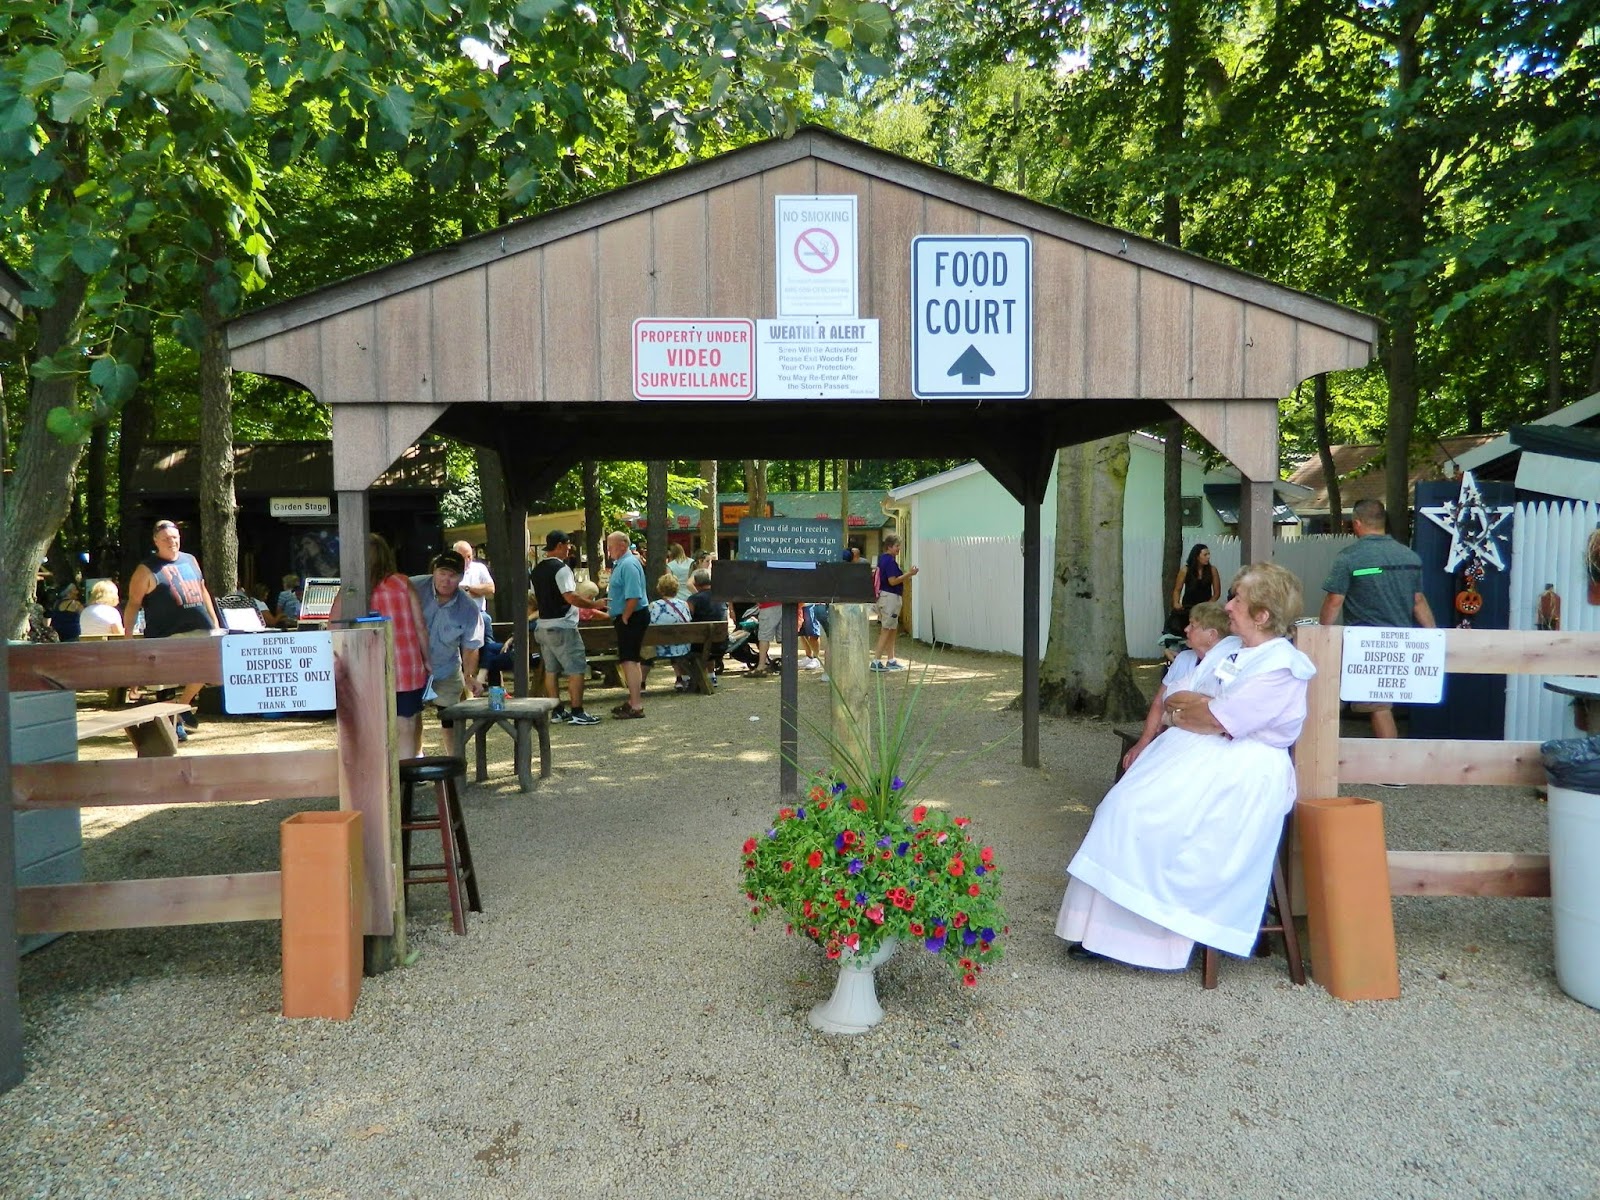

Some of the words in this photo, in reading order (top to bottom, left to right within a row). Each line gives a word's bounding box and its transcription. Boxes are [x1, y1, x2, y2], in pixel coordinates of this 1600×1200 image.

[783, 211, 798, 222] NO
[801, 211, 849, 222] SMOKING
[936, 251, 1008, 286] FOOD
[926, 299, 1016, 334] COURT
[641, 331, 702, 342] PROPERTY
[707, 331, 747, 342] UNDER
[830, 326, 865, 339] ALERT
[667, 349, 720, 366] VIDEO
[641, 373, 747, 387] SURVEILLANCE
[305, 503, 326, 511] Stage
[750, 546, 774, 554] Name,
[263, 637, 295, 645] BEFORE
[1361, 640, 1398, 648] ENTERING
[241, 647, 282, 656] ENTERING
[1365, 652, 1405, 662] DISPOSE
[1412, 653, 1424, 663] OF
[247, 659, 292, 670] DISPOSE
[300, 658, 313, 668] OF
[1348, 664, 1409, 676] CIGARETTES
[1415, 666, 1439, 676] ONLY
[230, 672, 298, 685] CIGARETTES
[305, 671, 331, 682] ONLY
[1378, 678, 1406, 688] HERE
[266, 686, 297, 697] HERE
